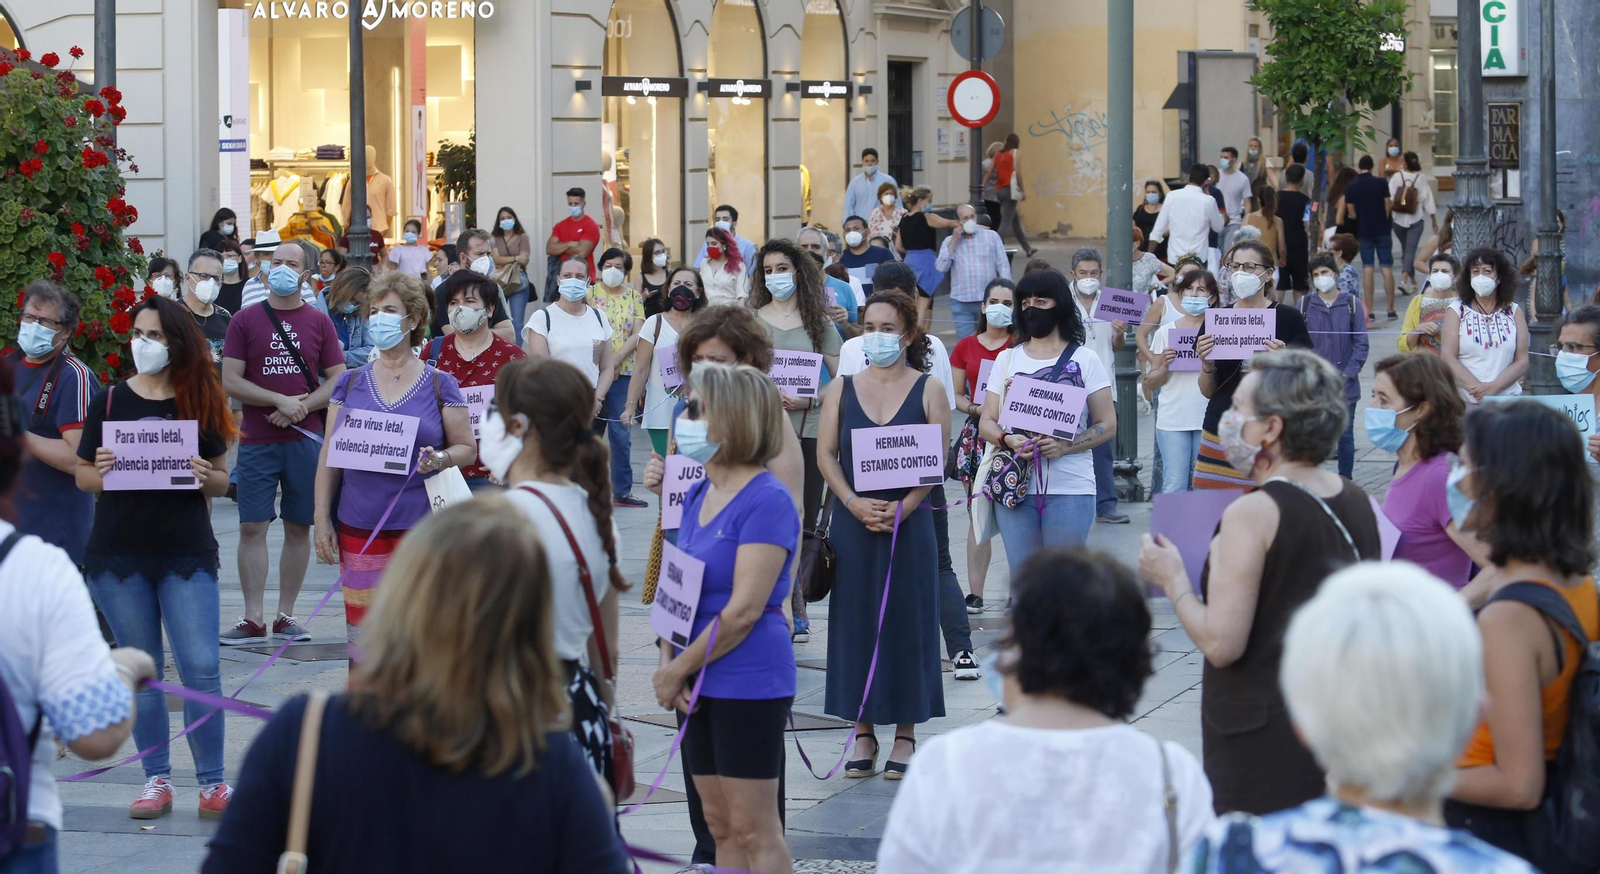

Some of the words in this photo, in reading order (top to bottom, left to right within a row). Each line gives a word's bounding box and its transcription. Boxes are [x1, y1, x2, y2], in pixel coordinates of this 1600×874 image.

[252, 1, 349, 18] ALVARO
[391, 1, 495, 19] MORENO
[1492, 126, 1514, 142] MA
[1491, 143, 1519, 160] CIA
[1100, 304, 1122, 314] ESTAMOS
[1122, 308, 1142, 317] CONTIGO
[1214, 314, 1230, 325] Para
[1230, 314, 1247, 325] virus
[1248, 314, 1265, 328] letal,
[1212, 334, 1238, 346] iolencia
[264, 356, 295, 366] DRIVE
[784, 358, 788, 368] y
[788, 356, 817, 368] condenamos
[262, 365, 307, 375] DAEWO
[788, 375, 812, 386] machistas
[38, 393, 48, 410] EOS
[466, 391, 484, 405] letal,
[1028, 387, 1064, 405] HERMANA,
[1008, 401, 1042, 417] ESTAMOS
[1042, 408, 1076, 425] CONTIGO
[344, 414, 362, 429] Para
[364, 418, 384, 432] virus
[384, 420, 404, 436] letal,
[115, 429, 135, 444] Para
[137, 429, 160, 444] virus
[161, 428, 184, 446] letal,
[875, 435, 918, 450] HERMANA,
[335, 438, 370, 454] violencia
[370, 443, 409, 458] patriarcal
[860, 458, 900, 473] ESTAMOS
[900, 455, 938, 469] CONTIGO
[678, 465, 708, 481] JUS
